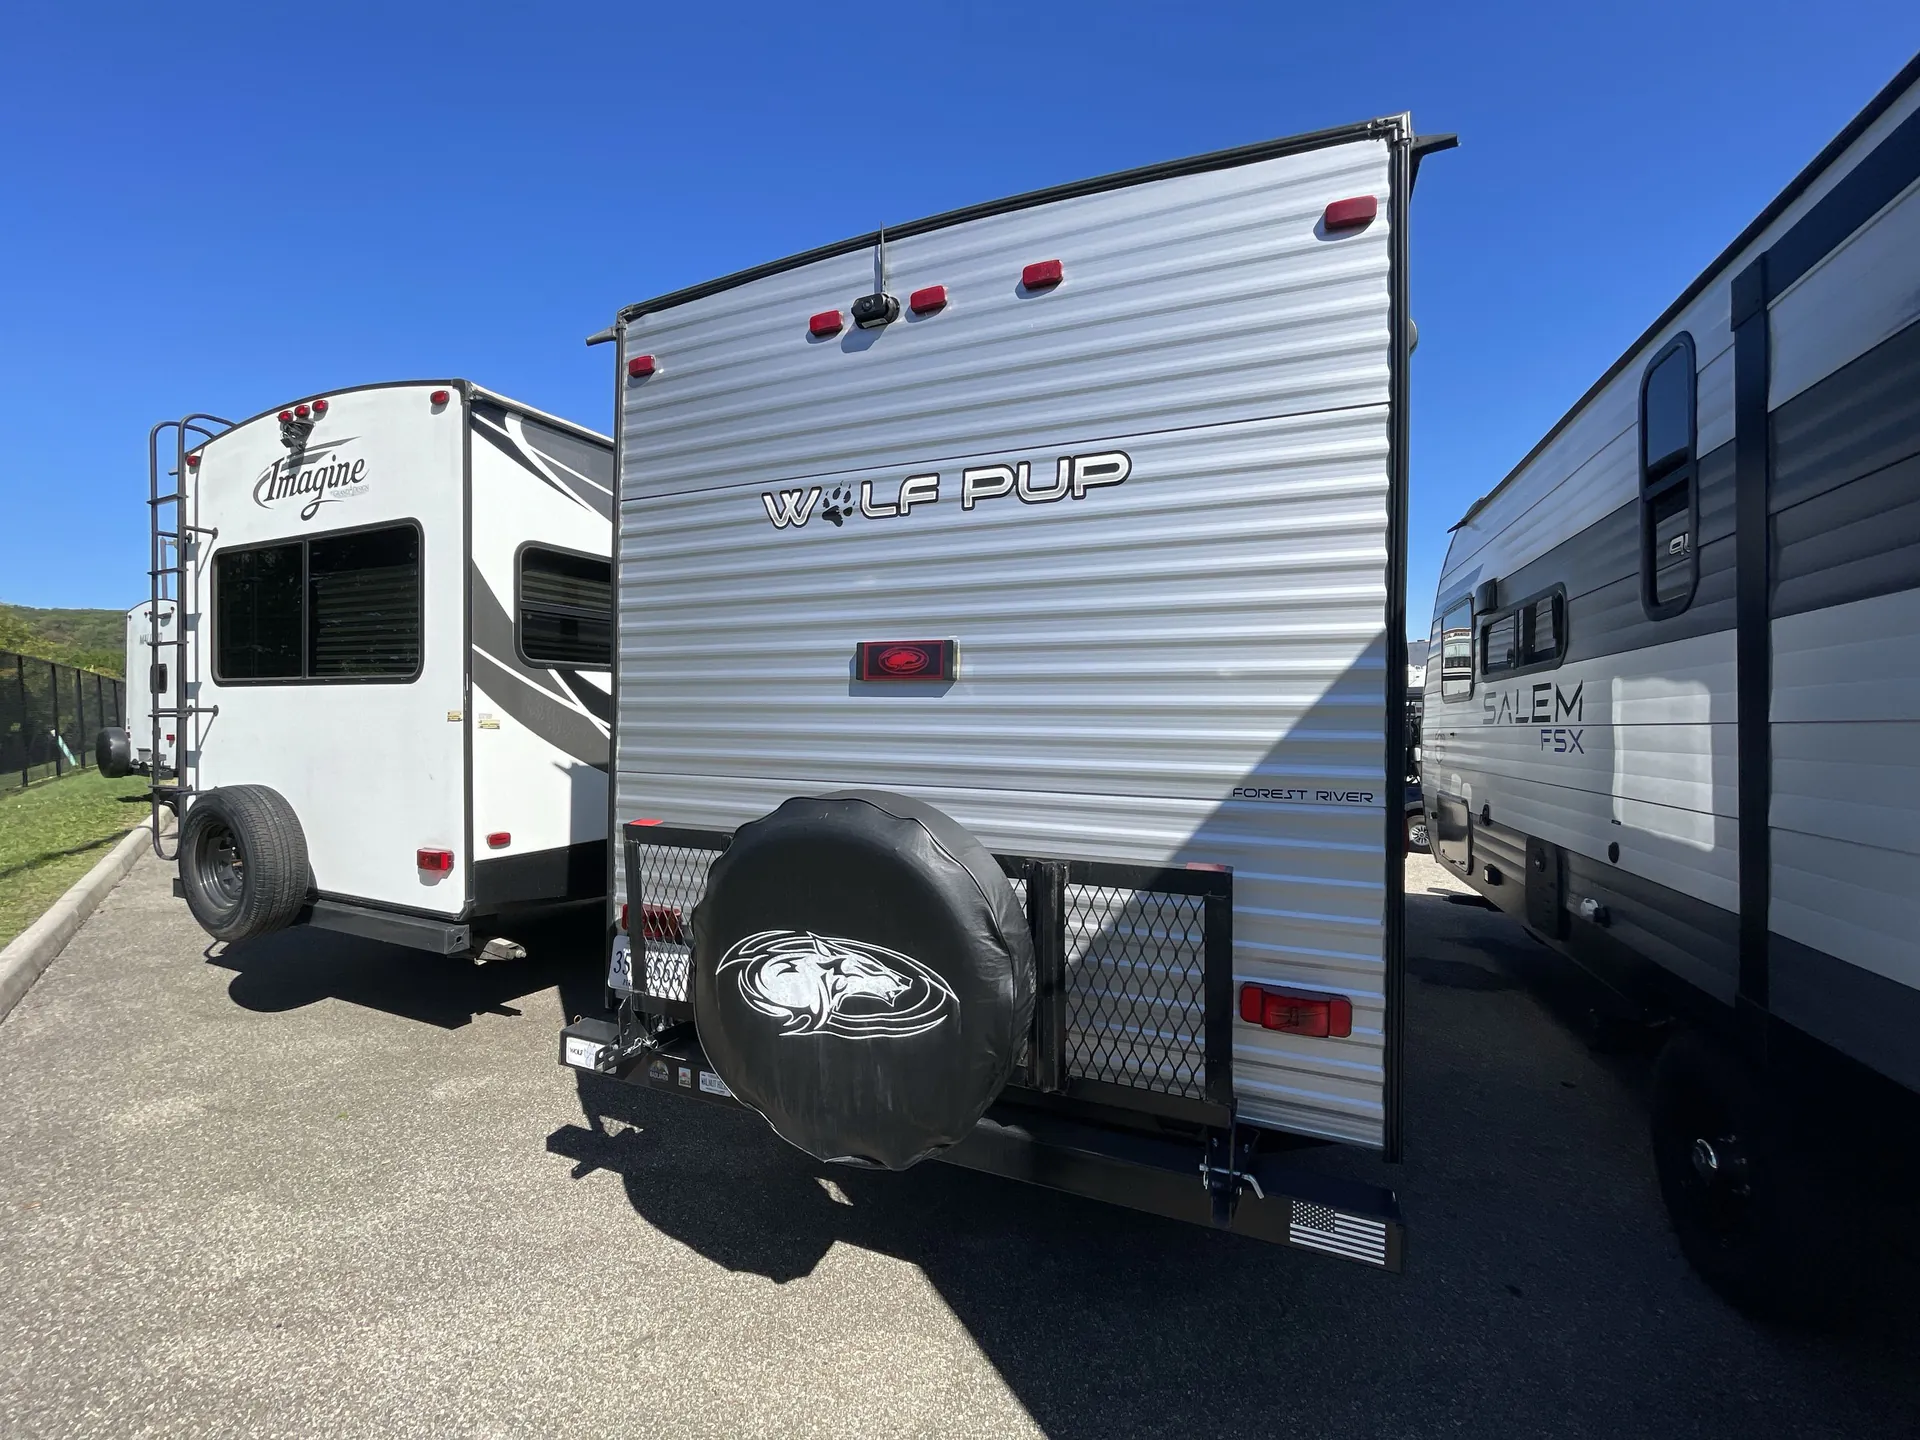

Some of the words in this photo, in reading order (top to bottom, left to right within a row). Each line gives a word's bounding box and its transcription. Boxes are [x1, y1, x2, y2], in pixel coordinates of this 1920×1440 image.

[262, 454, 370, 521] Imagine
[962, 450, 1132, 511] PUP
[1482, 679, 1583, 725] SALEM
[1540, 729, 1584, 754] FSX
[1232, 787, 1308, 800] FOREST
[1316, 790, 1374, 803] RIVER
